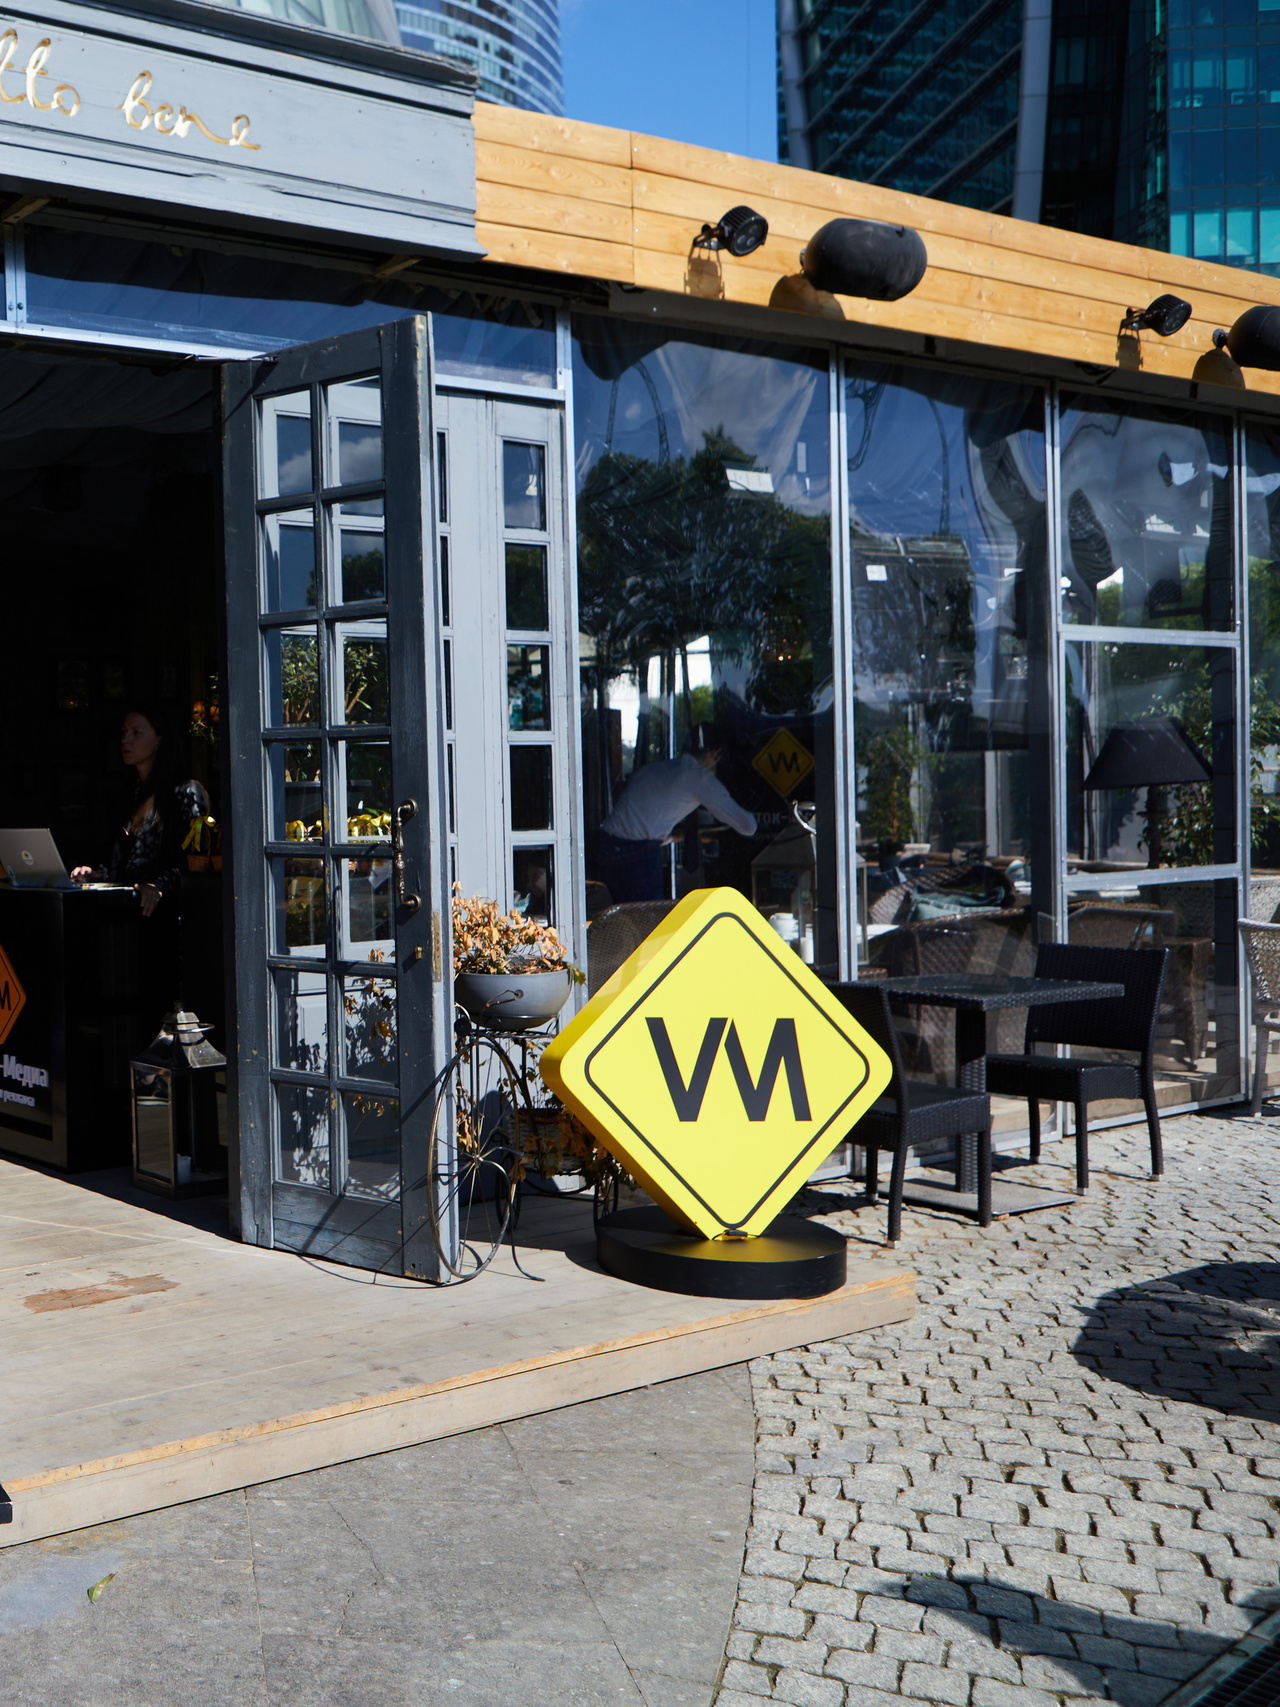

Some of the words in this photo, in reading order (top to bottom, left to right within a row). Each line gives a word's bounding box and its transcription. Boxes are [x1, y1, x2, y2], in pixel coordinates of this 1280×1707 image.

[116, 70, 261, 151] bene
[768, 752, 801, 773] VM
[644, 1016, 813, 1122] VM
